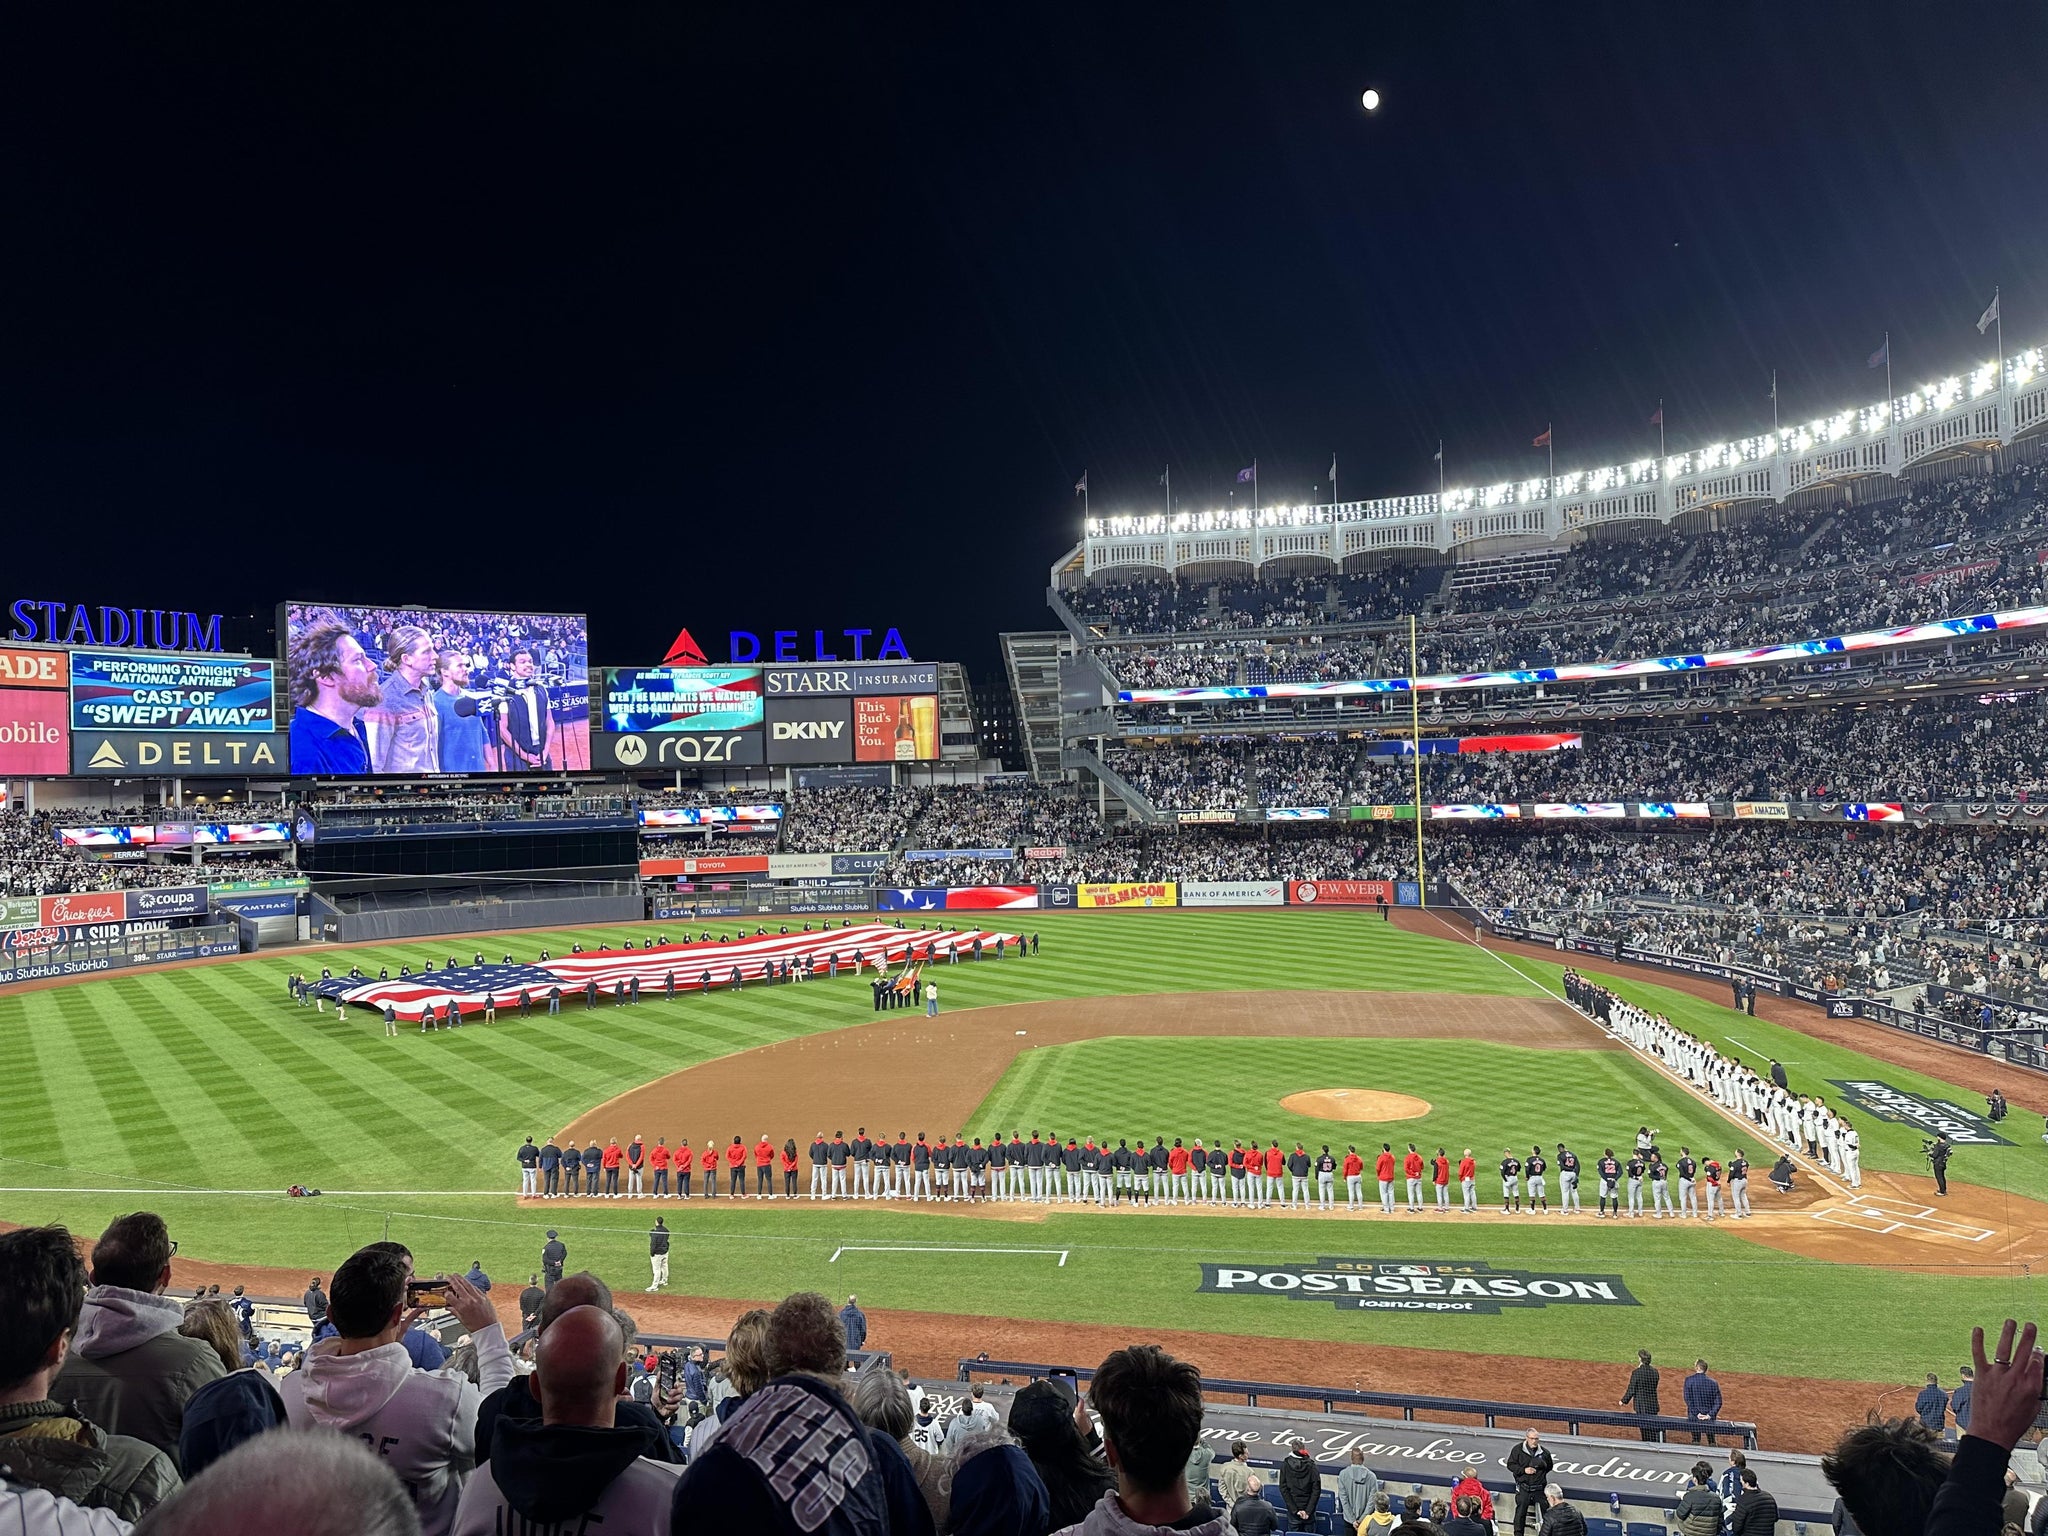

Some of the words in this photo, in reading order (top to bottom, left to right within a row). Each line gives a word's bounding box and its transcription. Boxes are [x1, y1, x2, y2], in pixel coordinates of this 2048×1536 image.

[9, 599, 225, 652] STADIUM
[730, 627, 911, 664] DELTA
[93, 660, 181, 674] PERFORMING
[183, 664, 252, 677] TONIGHT'S
[110, 672, 179, 685] NATIONAL
[179, 674, 237, 687] ANTHEM:
[703, 672, 720, 680] SCOTT
[720, 672, 731, 680] KEY
[767, 671, 853, 693] STARR
[859, 673, 934, 685] INSURANCE
[132, 690, 184, 705] CAST
[189, 691, 216, 706] OF
[632, 691, 649, 703] THE
[649, 691, 698, 703] RAMPARTS
[699, 691, 714, 703] WE
[715, 691, 758, 702] WATCHED
[608, 703, 635, 714] WERE
[636, 703, 649, 713] SO
[650, 703, 698, 714] GALLANTLY
[857, 701, 886, 712] This
[772, 720, 845, 740] DKNY
[859, 724, 880, 735] For
[858, 735, 886, 746] You.
[138, 741, 276, 765] DELTA
[658, 735, 743, 763] razr
[1177, 812, 1198, 820] Parts
[1199, 811, 1236, 820] Authority
[1754, 805, 1786, 815] AMAZING
[751, 823, 776, 831] TERRACE
[114, 850, 145, 859] TERRACE
[853, 860, 886, 868] CLEAR
[797, 879, 828, 888] BUILD
[1319, 883, 1342, 894] F.W.
[1345, 883, 1384, 895] WEBB
[156, 892, 195, 906] coupa
[1183, 890, 1208, 898] BANK
[20, 906, 37, 915] Circle
[52, 903, 115, 922] Chick-fil-A
[242, 902, 287, 911] AMTRAK
[844, 903, 869, 911] StubHub
[11, 927, 60, 945] Jersey
[74, 927, 85, 947] A
[89, 924, 120, 946] SUB
[156, 951, 177, 959] STARR
[213, 945, 237, 953] CLEAR
[133, 953, 146, 962] 399
[16, 964, 60, 980] StubHub
[64, 958, 109, 973] StubHub
[1795, 987, 1818, 1001] loanDepot
[1833, 1006, 1854, 1014] ALCS
[1845, 1081, 1998, 1143] POSTSEASON
[1604, 1164, 1616, 1174] 22
[1335, 1262, 1374, 1272] 20
[1435, 1265, 1475, 1273] 24
[1216, 1268, 1619, 1300] POSTSEASON
[1358, 1298, 1473, 1312] loanDepot
[914, 1428, 929, 1443] 25
[1271, 1428, 1314, 1446] to
[1316, 1428, 1488, 1464] Yankee
